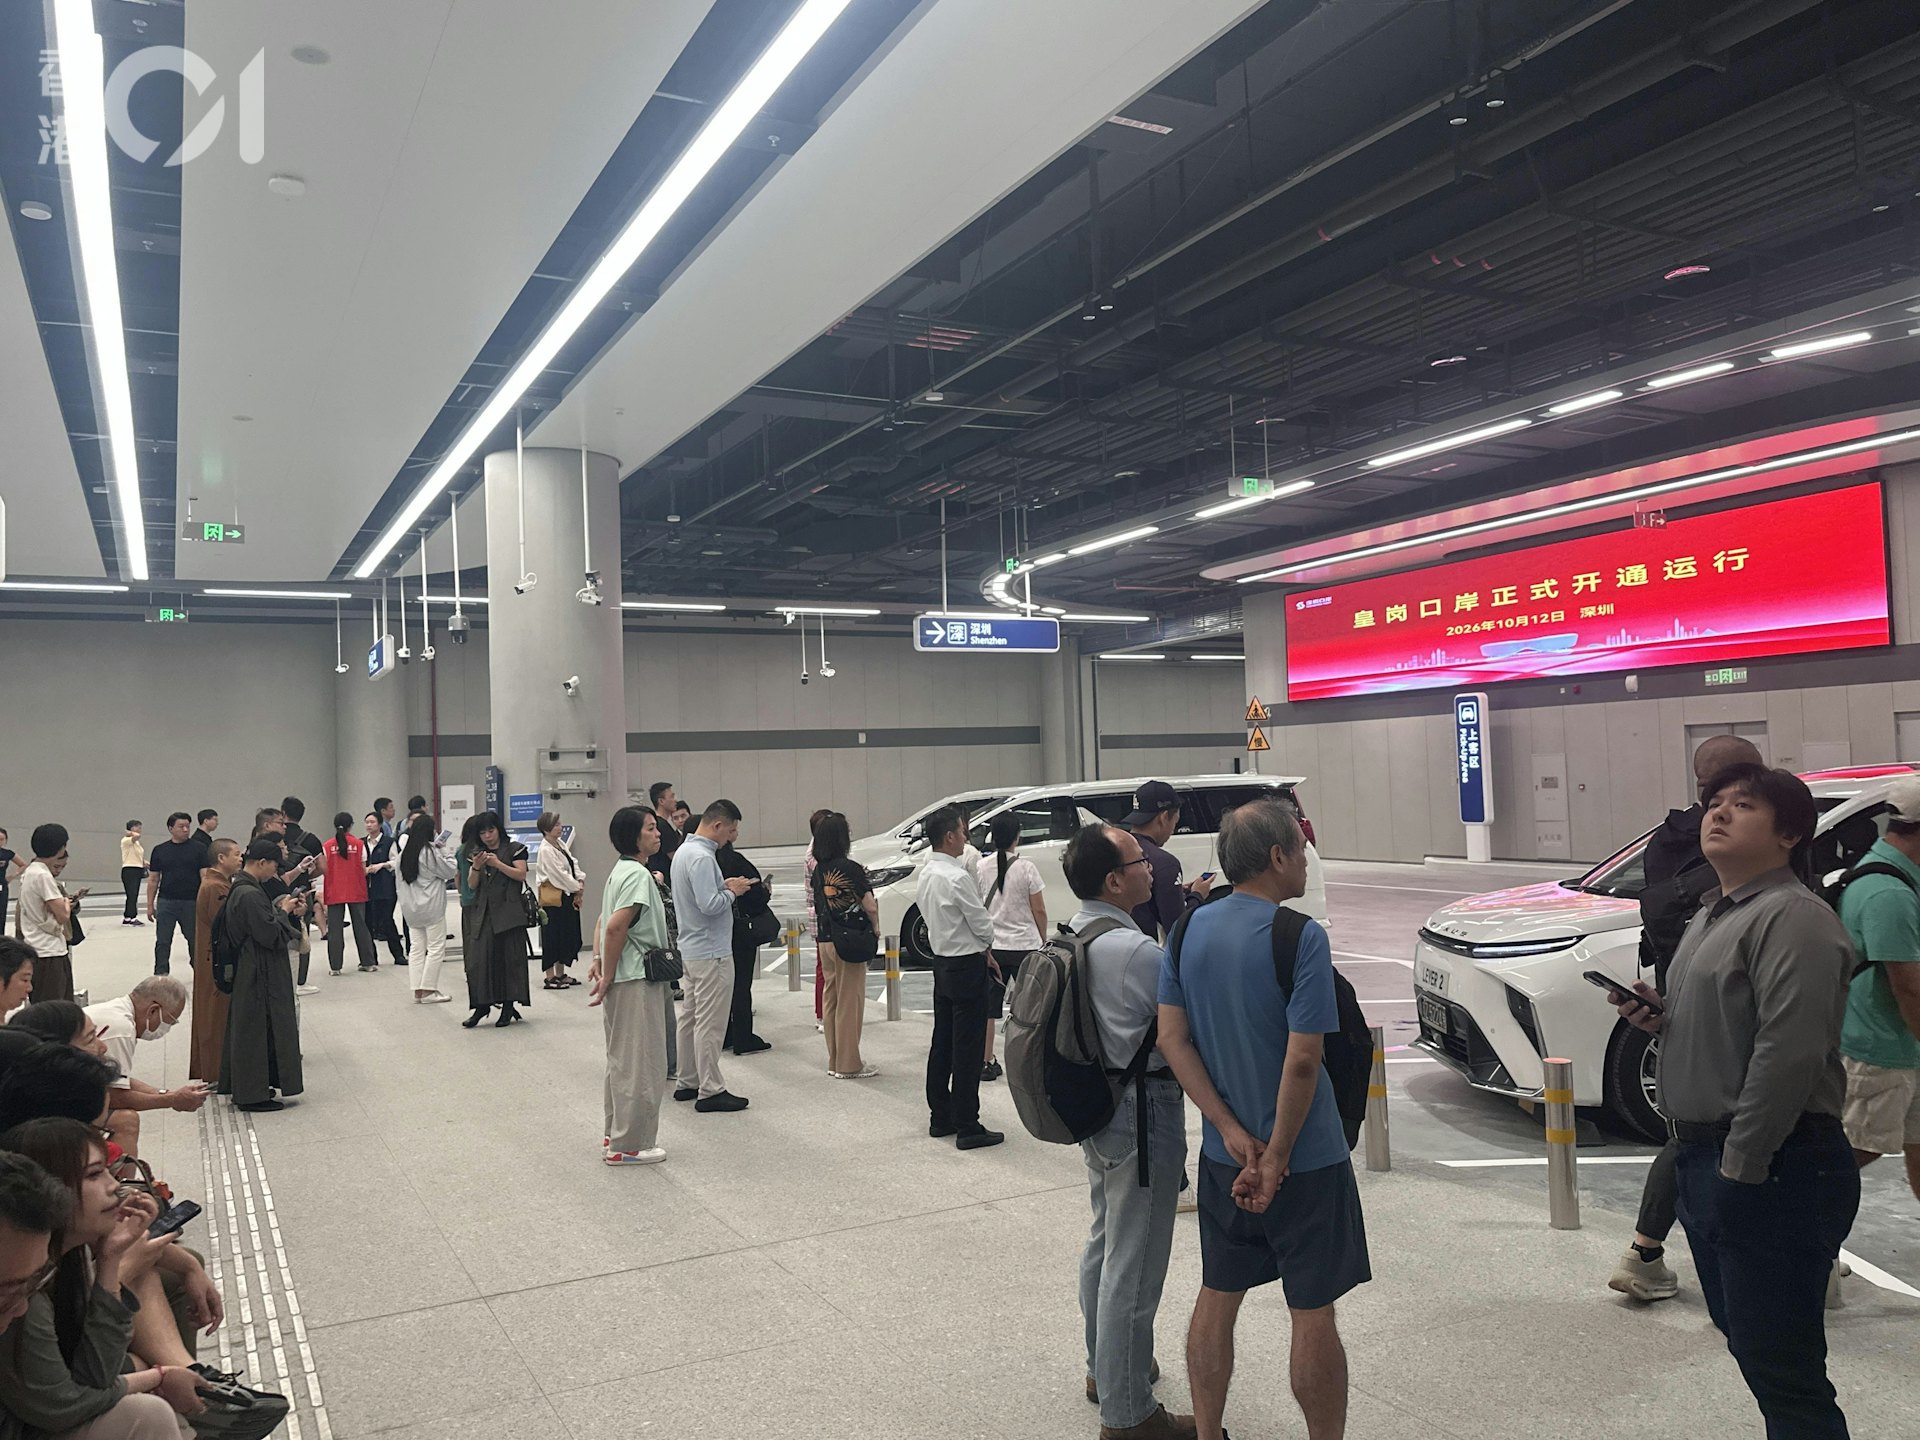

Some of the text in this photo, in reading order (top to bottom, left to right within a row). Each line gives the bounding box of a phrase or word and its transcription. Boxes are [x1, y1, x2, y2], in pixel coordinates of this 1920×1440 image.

[1353, 547, 1750, 628] 皇岗口岸正式开通运行
[970, 623, 992, 635] 深圳
[1446, 603, 1614, 636] 2026年10月12日 深圳
[970, 636, 1007, 645] Shenzhen
[1733, 671, 1747, 680] EXIT
[1468, 728, 1480, 768] 上客区
[1461, 762, 1469, 783] Area
[1439, 973, 1444, 990] 2
